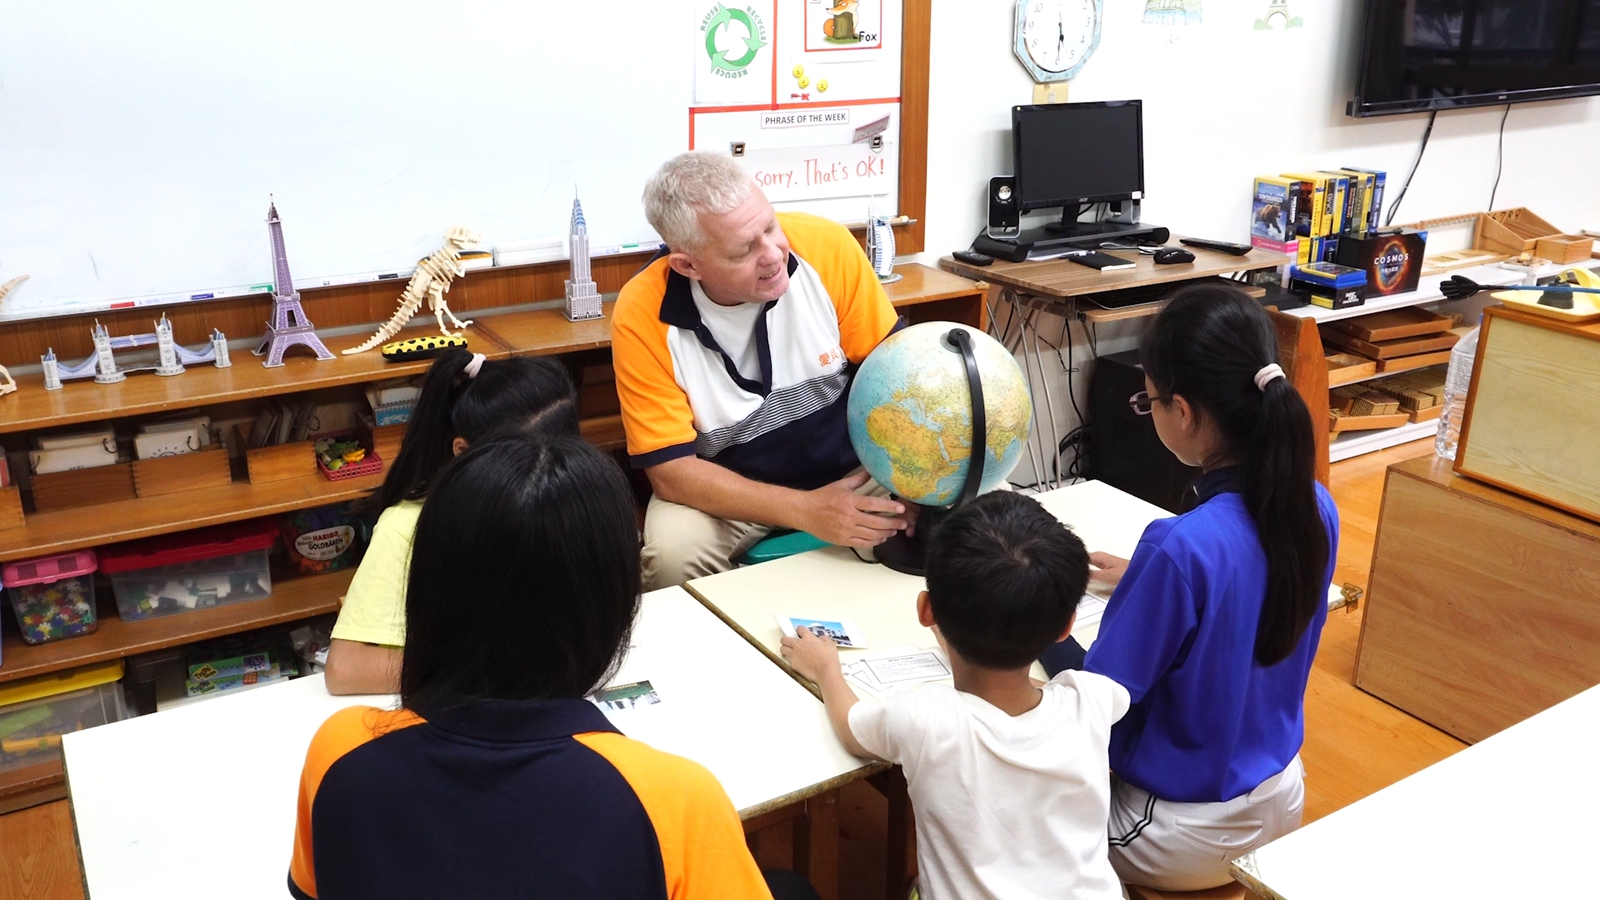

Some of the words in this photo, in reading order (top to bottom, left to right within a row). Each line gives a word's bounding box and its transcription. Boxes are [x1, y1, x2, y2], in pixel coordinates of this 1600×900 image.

[1035, 3, 1043, 13] 10
[700, 5, 719, 32] REUSE
[746, 5, 767, 41] RECYCLE
[1085, 17, 1091, 28] 3
[858, 31, 877, 42] Fox
[1079, 35, 1085, 45] 4
[1069, 49, 1075, 60] 5
[715, 67, 748, 79] REDUCE
[765, 116, 795, 125] PHRASE
[796, 115, 806, 123] OF
[809, 114, 823, 123] THE
[825, 113, 847, 122] WEEK
[803, 158, 849, 186] That's
[856, 156, 884, 178] OK!
[1374, 253, 1409, 265] COSMOS
[313, 530, 339, 542] HARIBO
